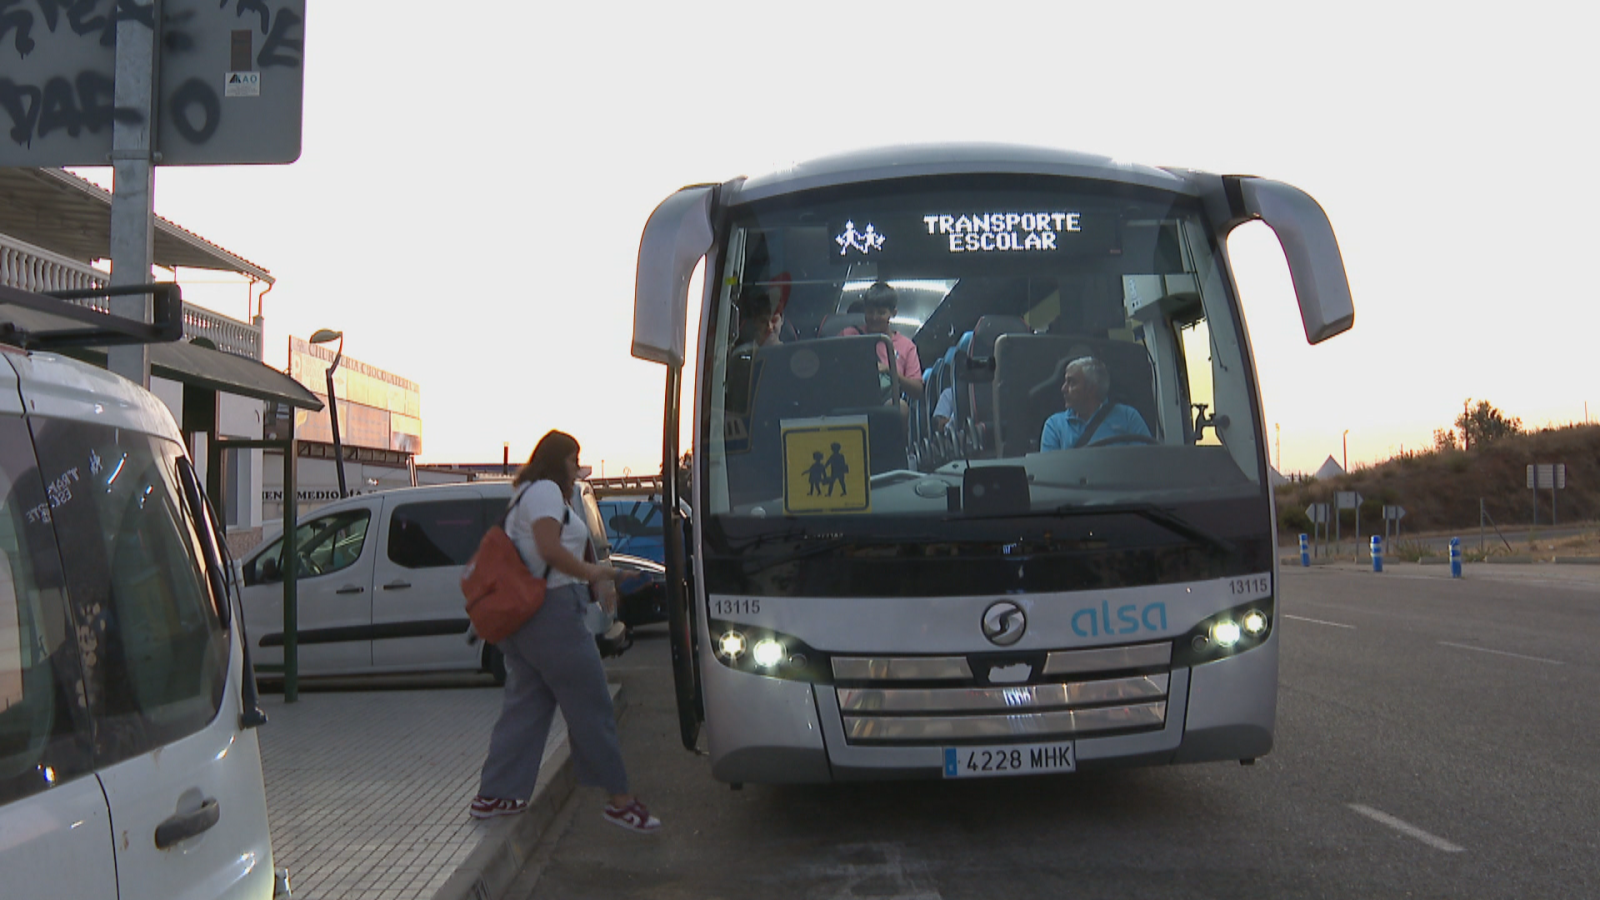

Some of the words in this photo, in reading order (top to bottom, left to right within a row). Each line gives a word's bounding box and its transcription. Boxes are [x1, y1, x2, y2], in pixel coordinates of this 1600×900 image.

[923, 212, 1081, 234] TRANSPORTE
[949, 231, 1057, 252] ESCOLAR
[1229, 578, 1268, 595] 13115
[714, 600, 760, 614] 13115
[1071, 600, 1168, 637] alsa
[967, 750, 1022, 771] 4228
[1030, 746, 1071, 769] MHK
